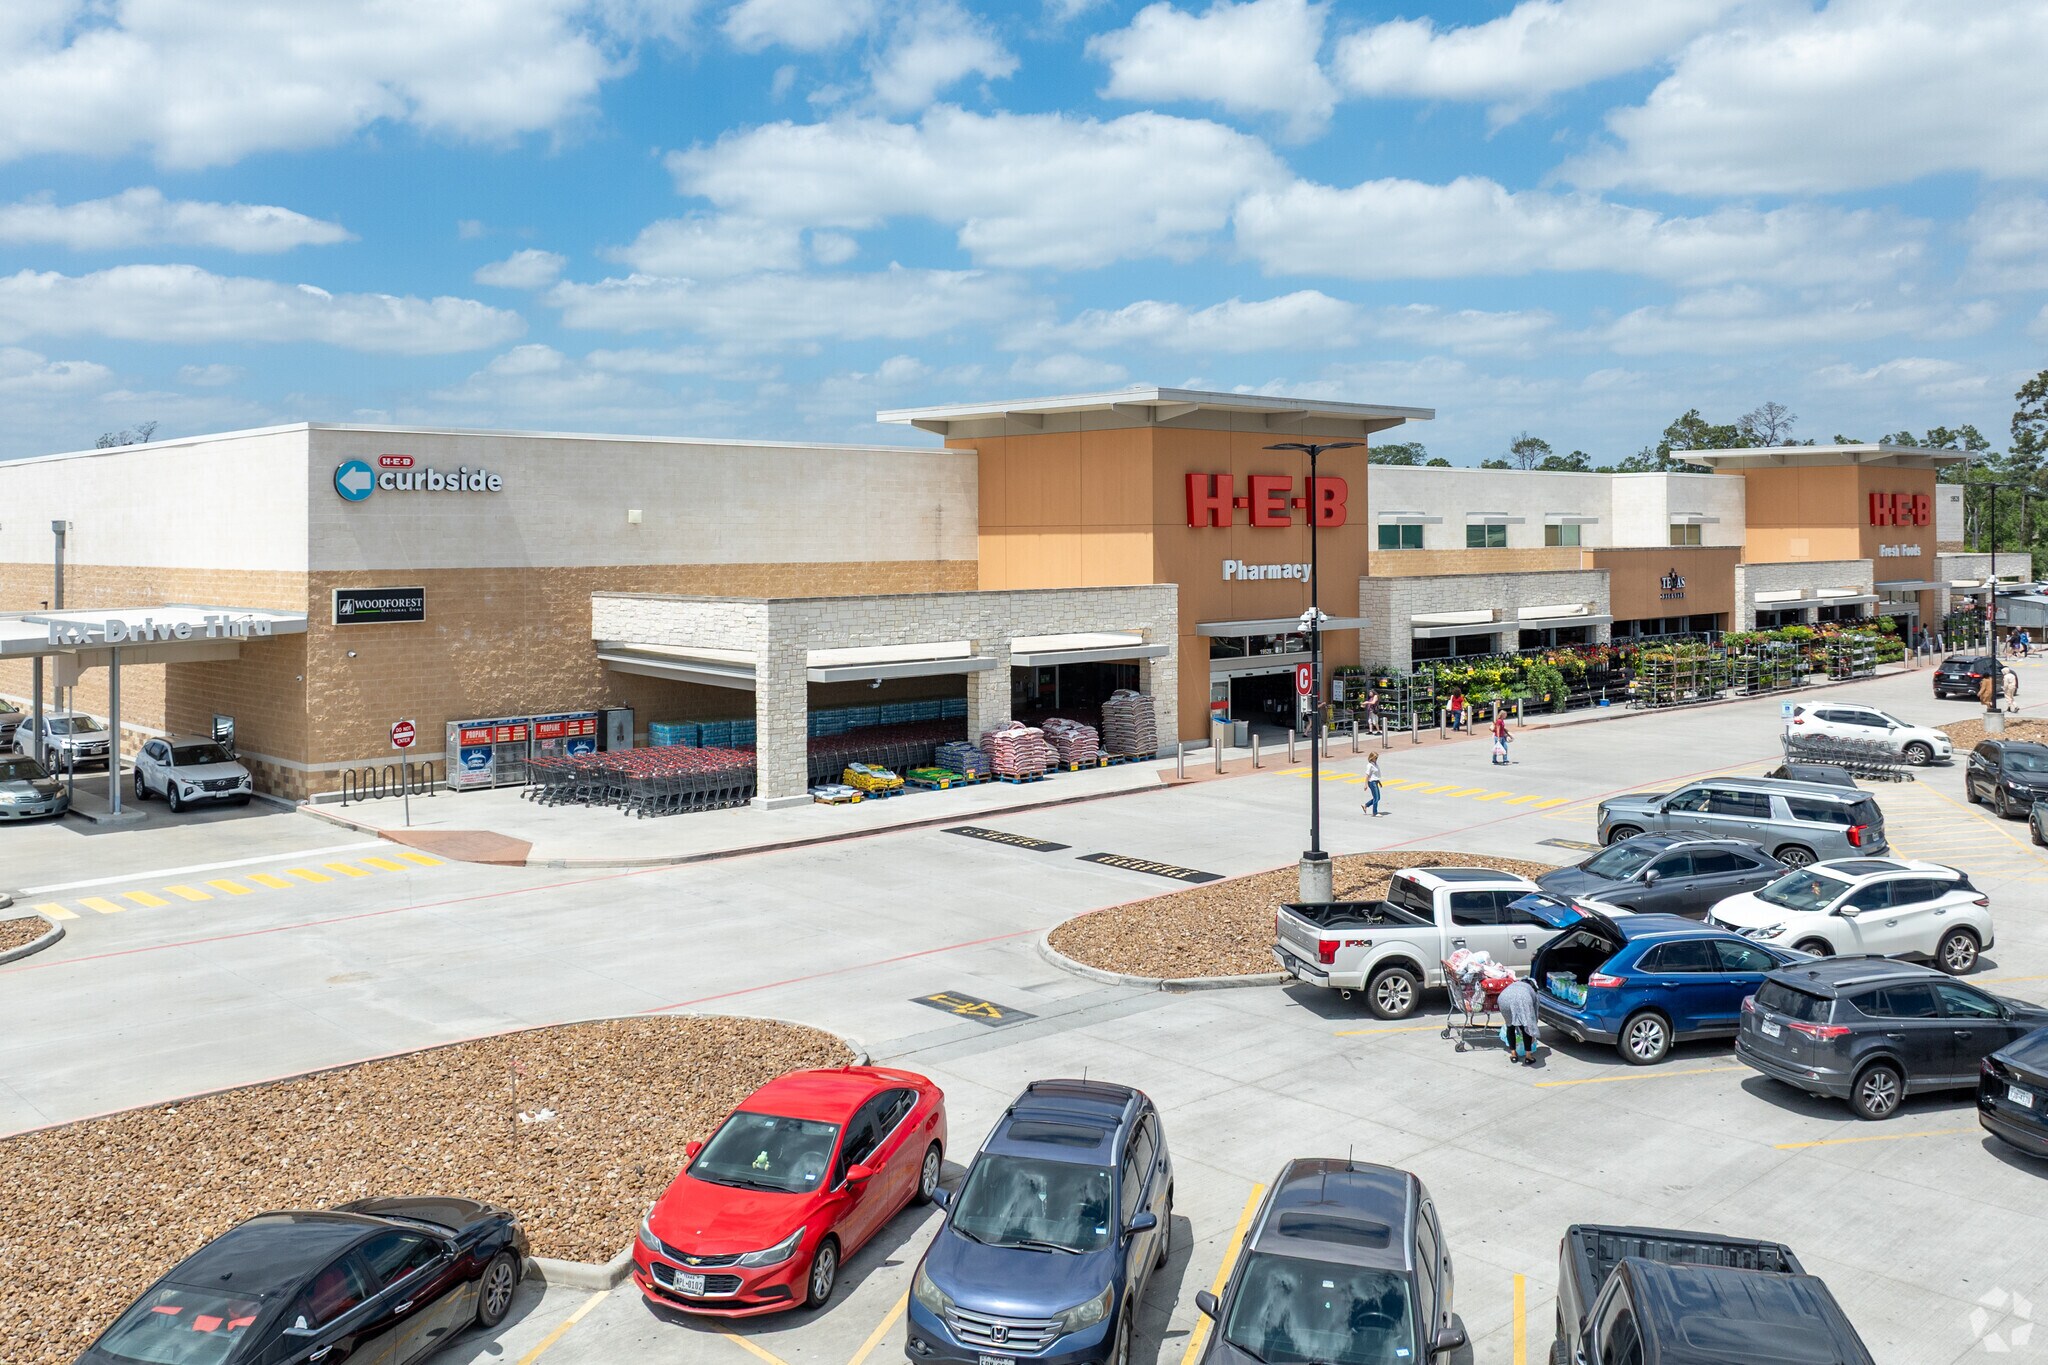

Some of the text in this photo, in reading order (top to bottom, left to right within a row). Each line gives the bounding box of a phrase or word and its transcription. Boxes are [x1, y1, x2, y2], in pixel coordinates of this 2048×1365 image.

[379, 467, 503, 492] curbside
[1185, 473, 1348, 528] H-E-B
[1869, 493, 1931, 527] H-E-B
[1879, 544, 1921, 557] Fresh Foods
[1222, 559, 1312, 583] Pharmacy
[355, 598, 423, 609] WOODFOREST
[48, 615, 272, 645] Rx Drive Thru
[1299, 668, 1309, 689] C
[466, 729, 488, 738] PROPANE
[541, 723, 560, 732] PROPANE
